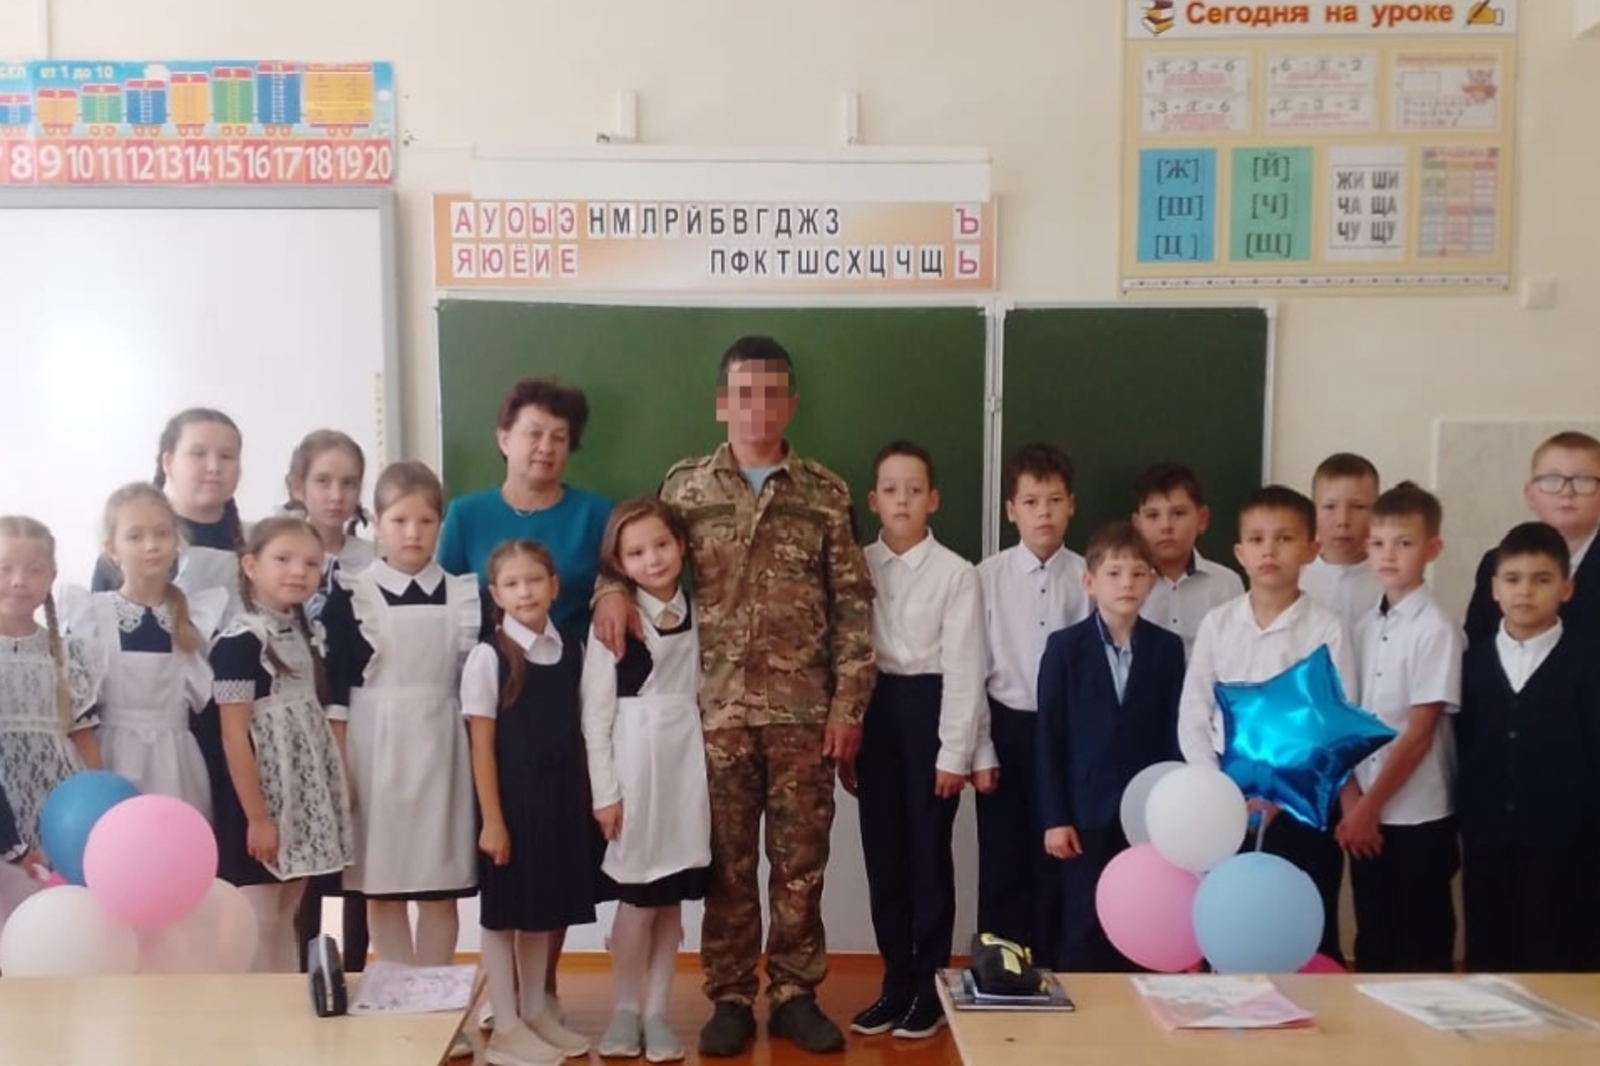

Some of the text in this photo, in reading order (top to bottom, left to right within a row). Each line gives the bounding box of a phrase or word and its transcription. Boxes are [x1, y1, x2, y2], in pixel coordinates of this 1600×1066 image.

[1186, 1, 1454, 27] Сегодня на уроке
[11, 145, 34, 180] 8
[38, 145, 62, 180] 9
[67, 145, 94, 180] 10
[98, 145, 124, 180] 11
[127, 145, 155, 180] 12
[156, 145, 183, 180] 13
[184, 145, 212, 180] 14
[214, 145, 242, 180] 15
[244, 145, 271, 180] 16
[273, 145, 304, 180] 17
[306, 145, 333, 180] 18
[335, 145, 362, 180] 19
[364, 145, 392, 180] 20
[1337, 170, 1398, 190] ЖИ ШИ
[1338, 196, 1397, 218] ЧА ЩА
[1338, 221, 1396, 245] ЧУ ЩУ
